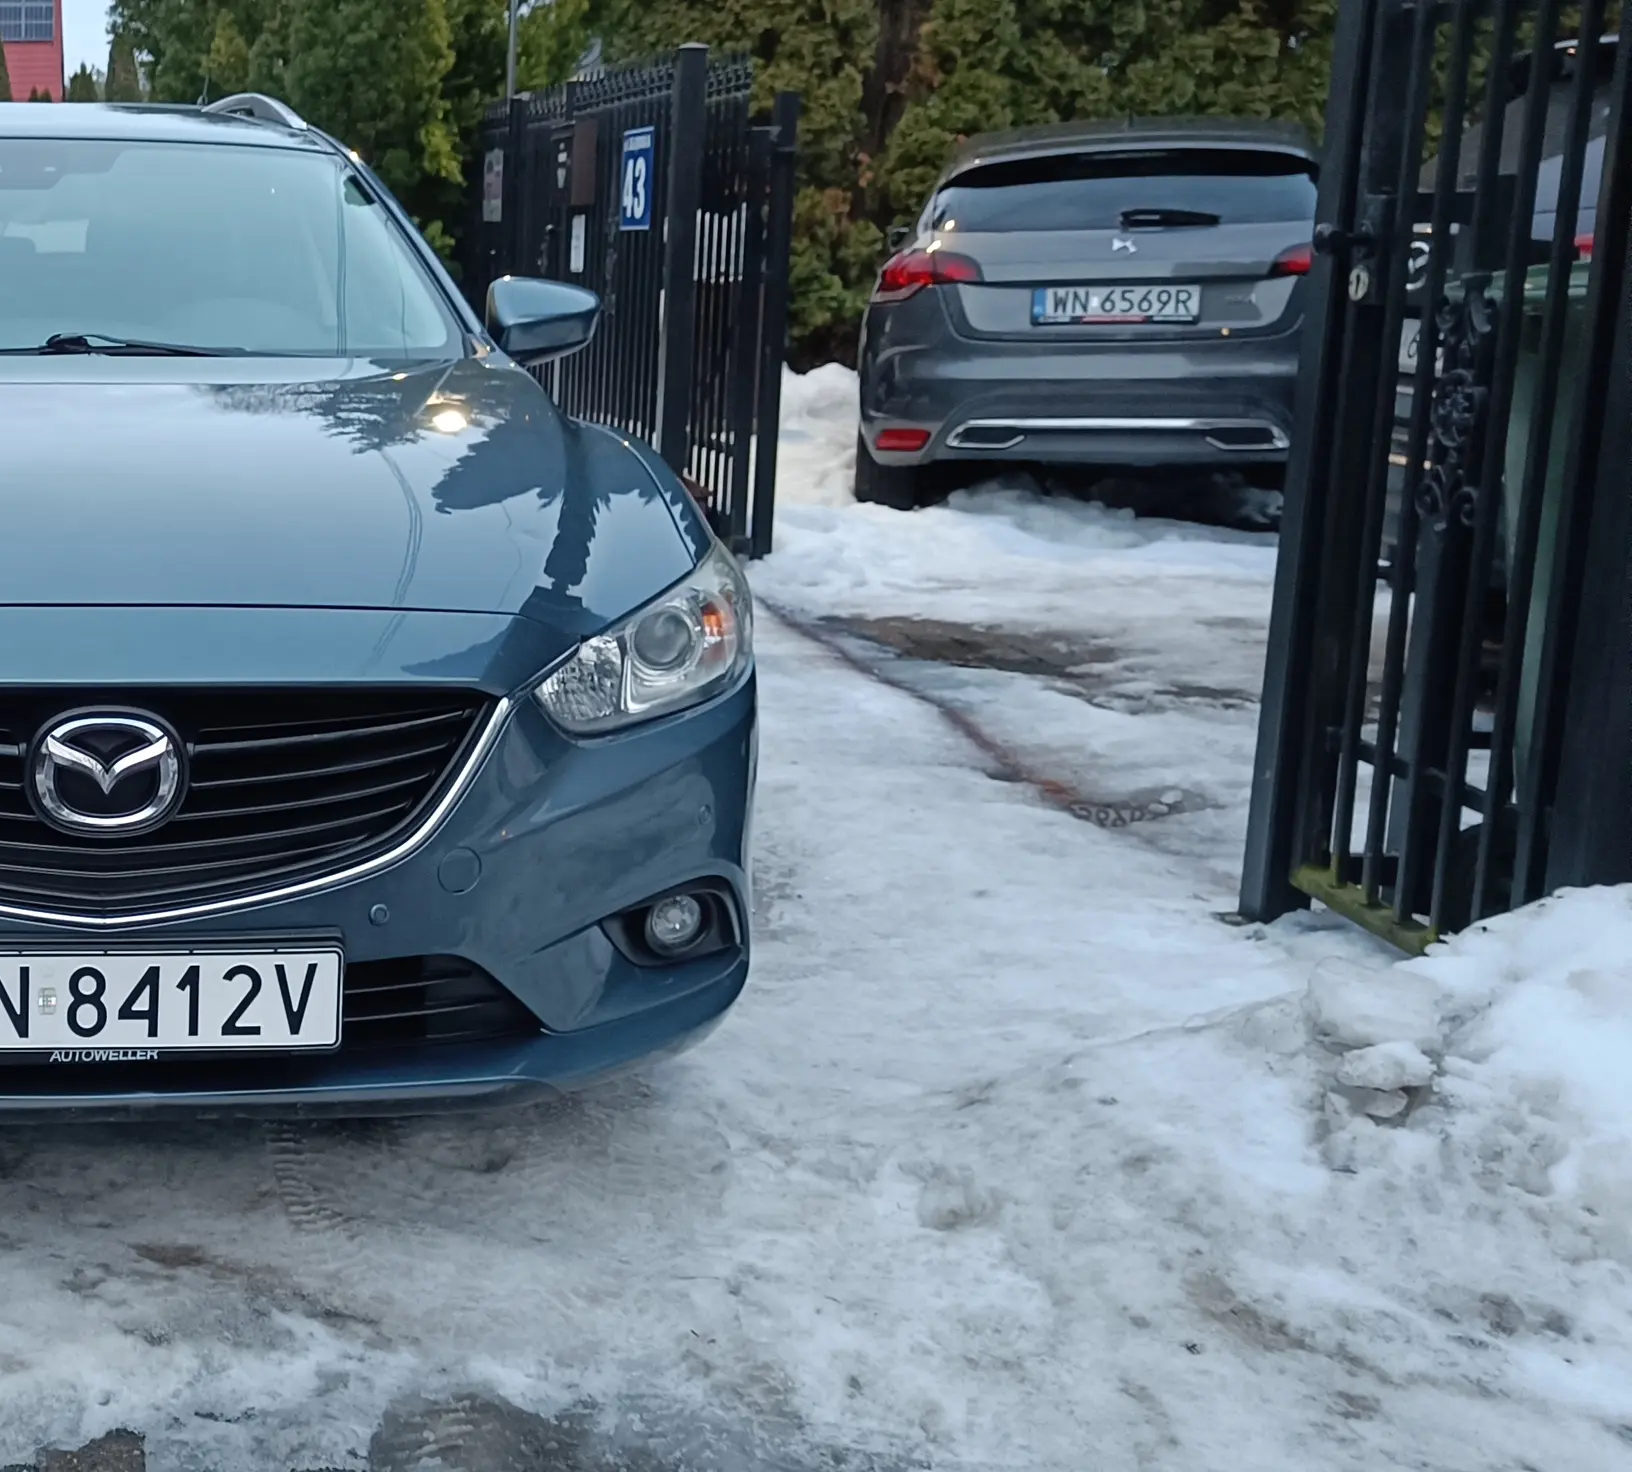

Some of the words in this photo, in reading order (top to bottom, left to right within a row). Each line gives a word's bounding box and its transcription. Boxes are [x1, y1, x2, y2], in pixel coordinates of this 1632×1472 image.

[622, 156, 646, 219] 43
[1053, 290, 1090, 314] WN
[1100, 289, 1193, 314] 6569R
[66, 963, 319, 1038] 8412V
[49, 1049, 158, 1062] AUTOWELLER
